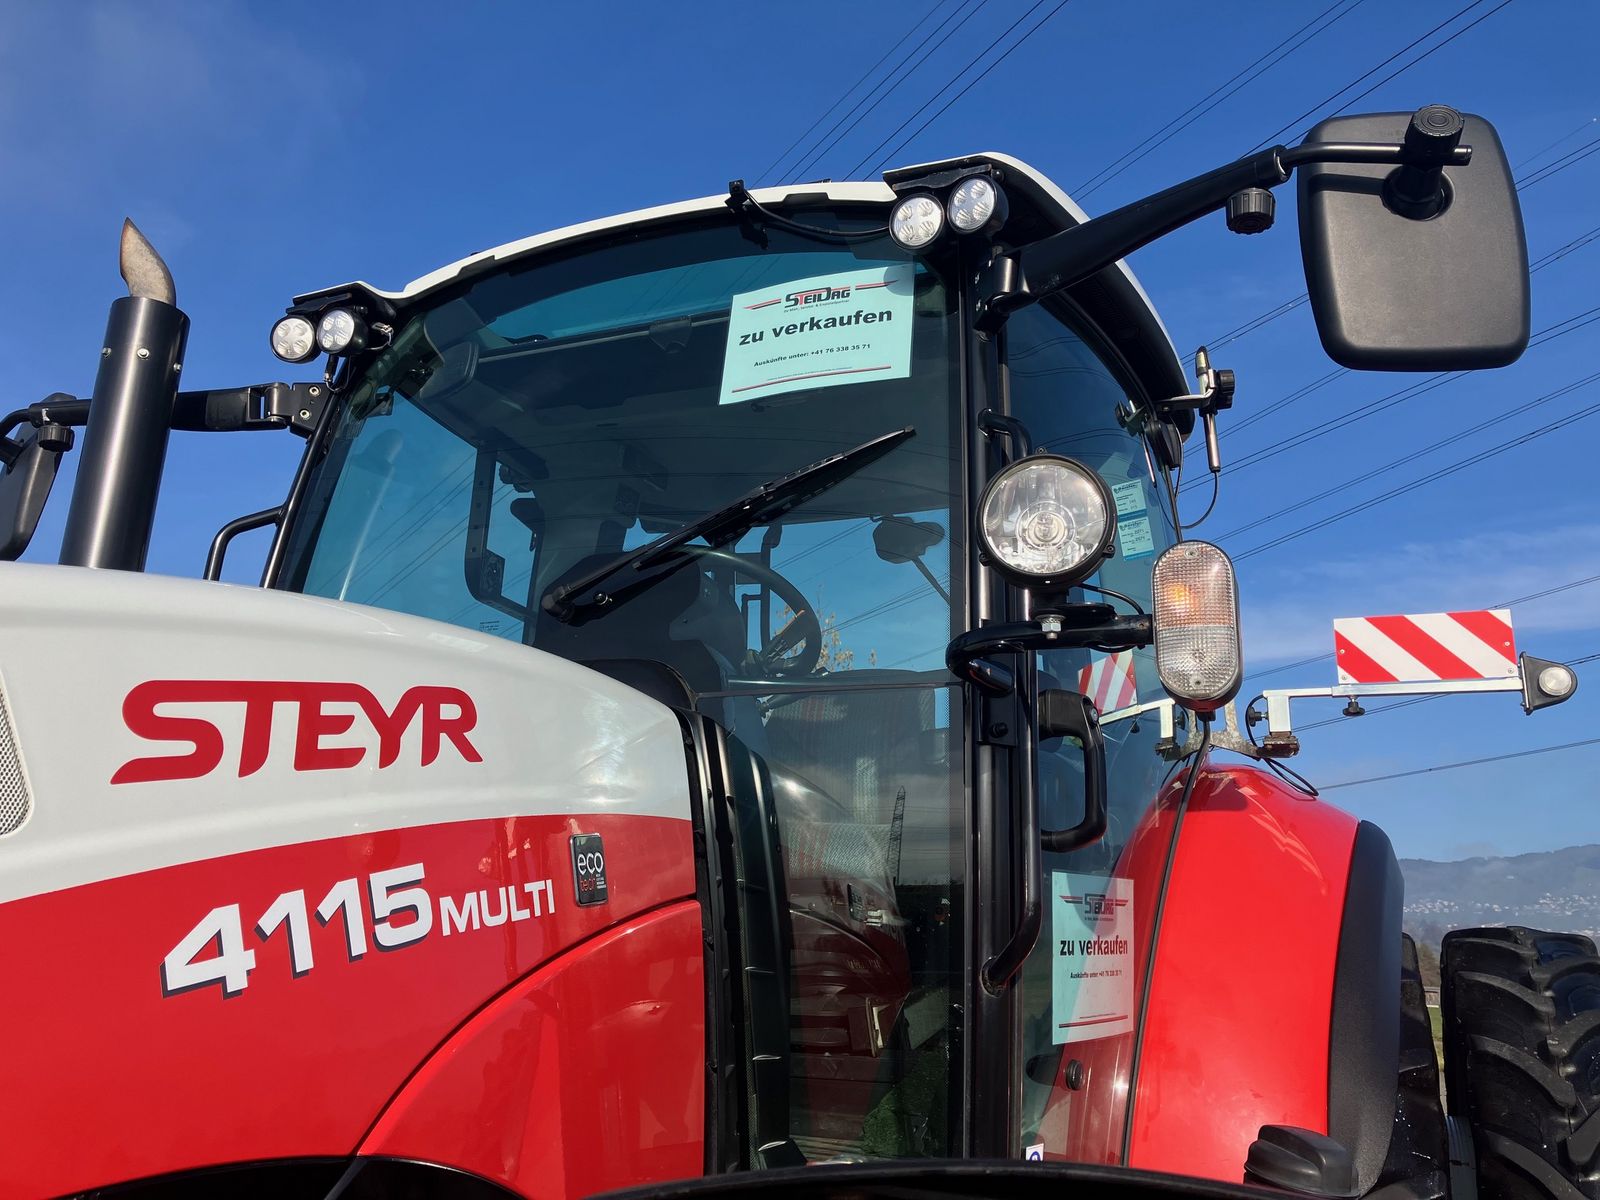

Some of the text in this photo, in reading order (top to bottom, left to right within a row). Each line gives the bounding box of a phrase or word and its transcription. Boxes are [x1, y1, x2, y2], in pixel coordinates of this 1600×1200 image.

[738, 309, 893, 346] zu verkaufen
[788, 351, 809, 360] unter:
[811, 348, 823, 357] +41
[825, 346, 834, 354] 76
[836, 345, 849, 353] 338
[109, 679, 484, 785] STEYR
[577, 852, 604, 875] eco
[160, 862, 556, 1000] 4115 MULTI
[1059, 935, 1128, 956] zu verkaufen
